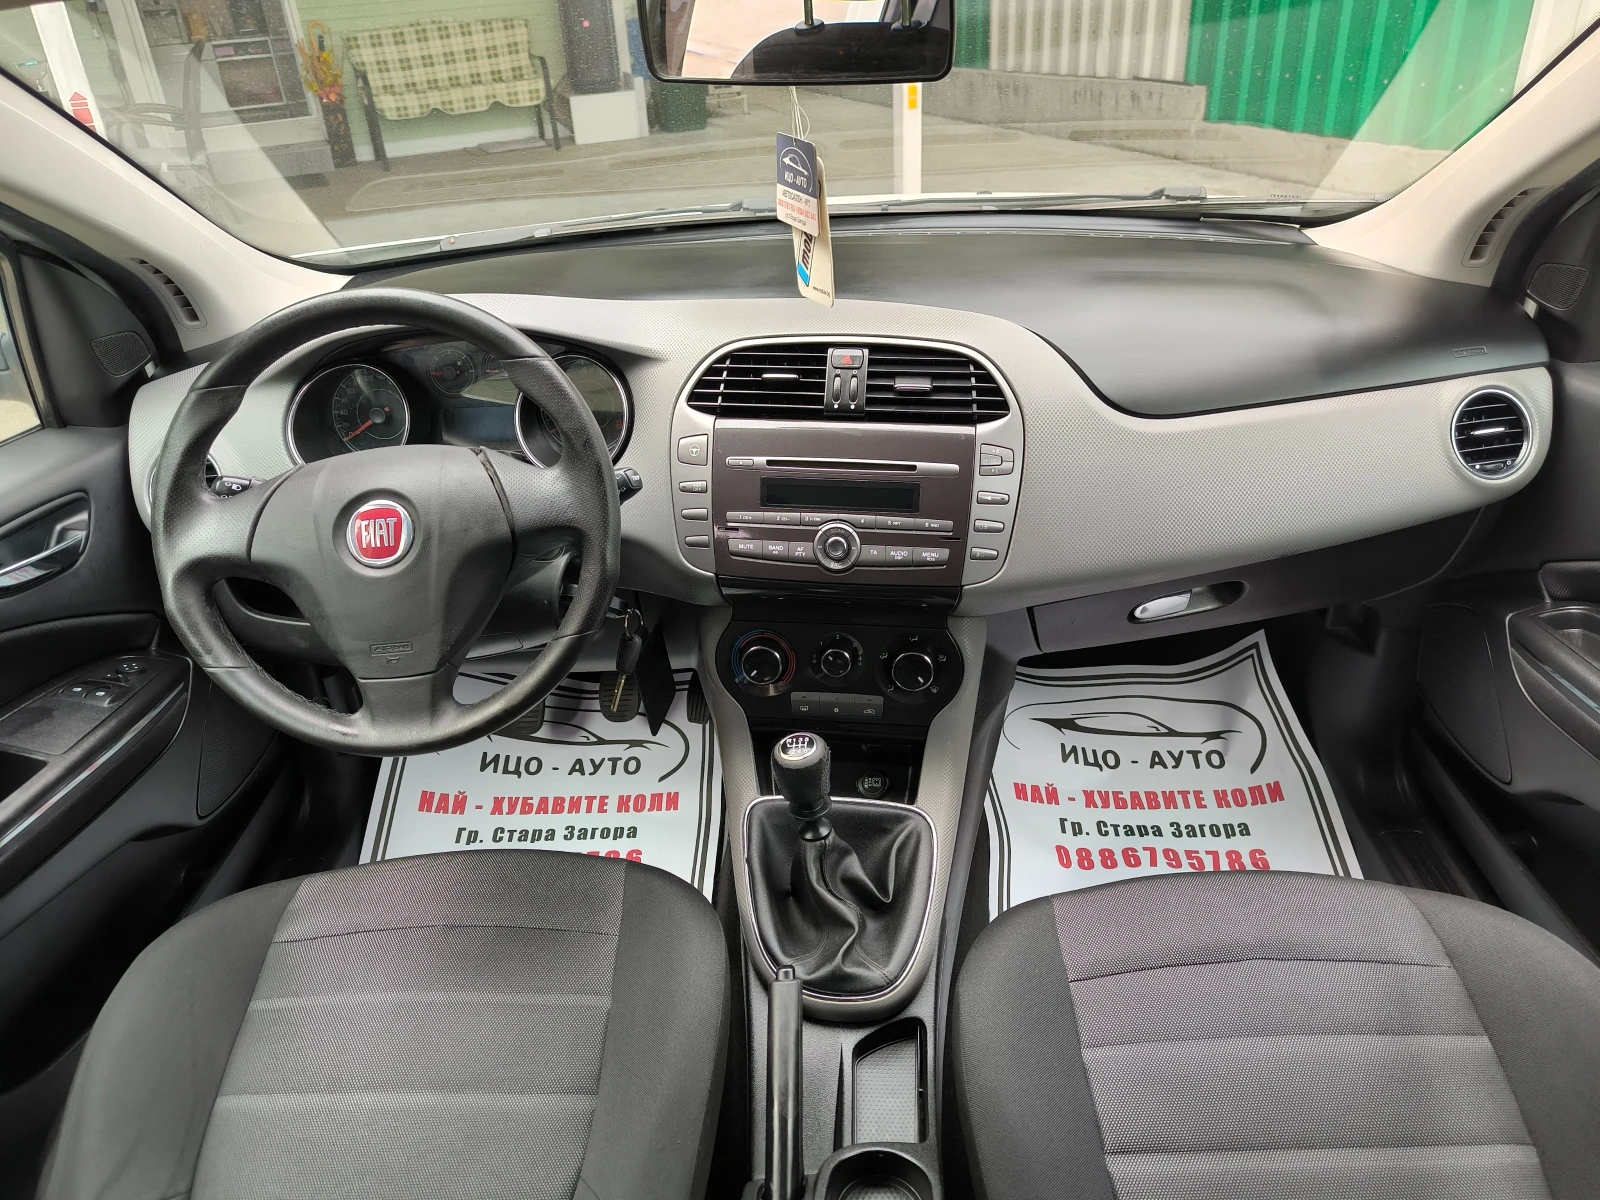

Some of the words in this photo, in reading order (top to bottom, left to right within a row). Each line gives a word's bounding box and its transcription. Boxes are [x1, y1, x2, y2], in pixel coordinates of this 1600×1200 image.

[784, 170, 793, 184] ИЦО
[796, 175, 808, 188] АУТО
[360, 518, 398, 548] FIAT
[479, 751, 543, 779] ИЦО
[567, 756, 642, 776] АУТО
[1060, 742, 1121, 772] ИЦО
[1149, 750, 1226, 770] АУТО
[418, 790, 468, 816] НАЙ
[490, 795, 610, 816] ХУБАВИТЕ
[616, 792, 681, 814] КОЛИ
[1013, 782, 1061, 806] НАЙ
[1082, 789, 1208, 810] ХУБАВИТЕ
[1213, 781, 1285, 809] КОЛИ
[455, 827, 484, 845] Гр.
[491, 826, 556, 844] Стара
[563, 825, 638, 841] Загора
[1058, 817, 1090, 837] Гр.
[1096, 820, 1164, 839] Стара
[1169, 822, 1251, 839] Загора
[1055, 844, 1271, 872] 0886795786
